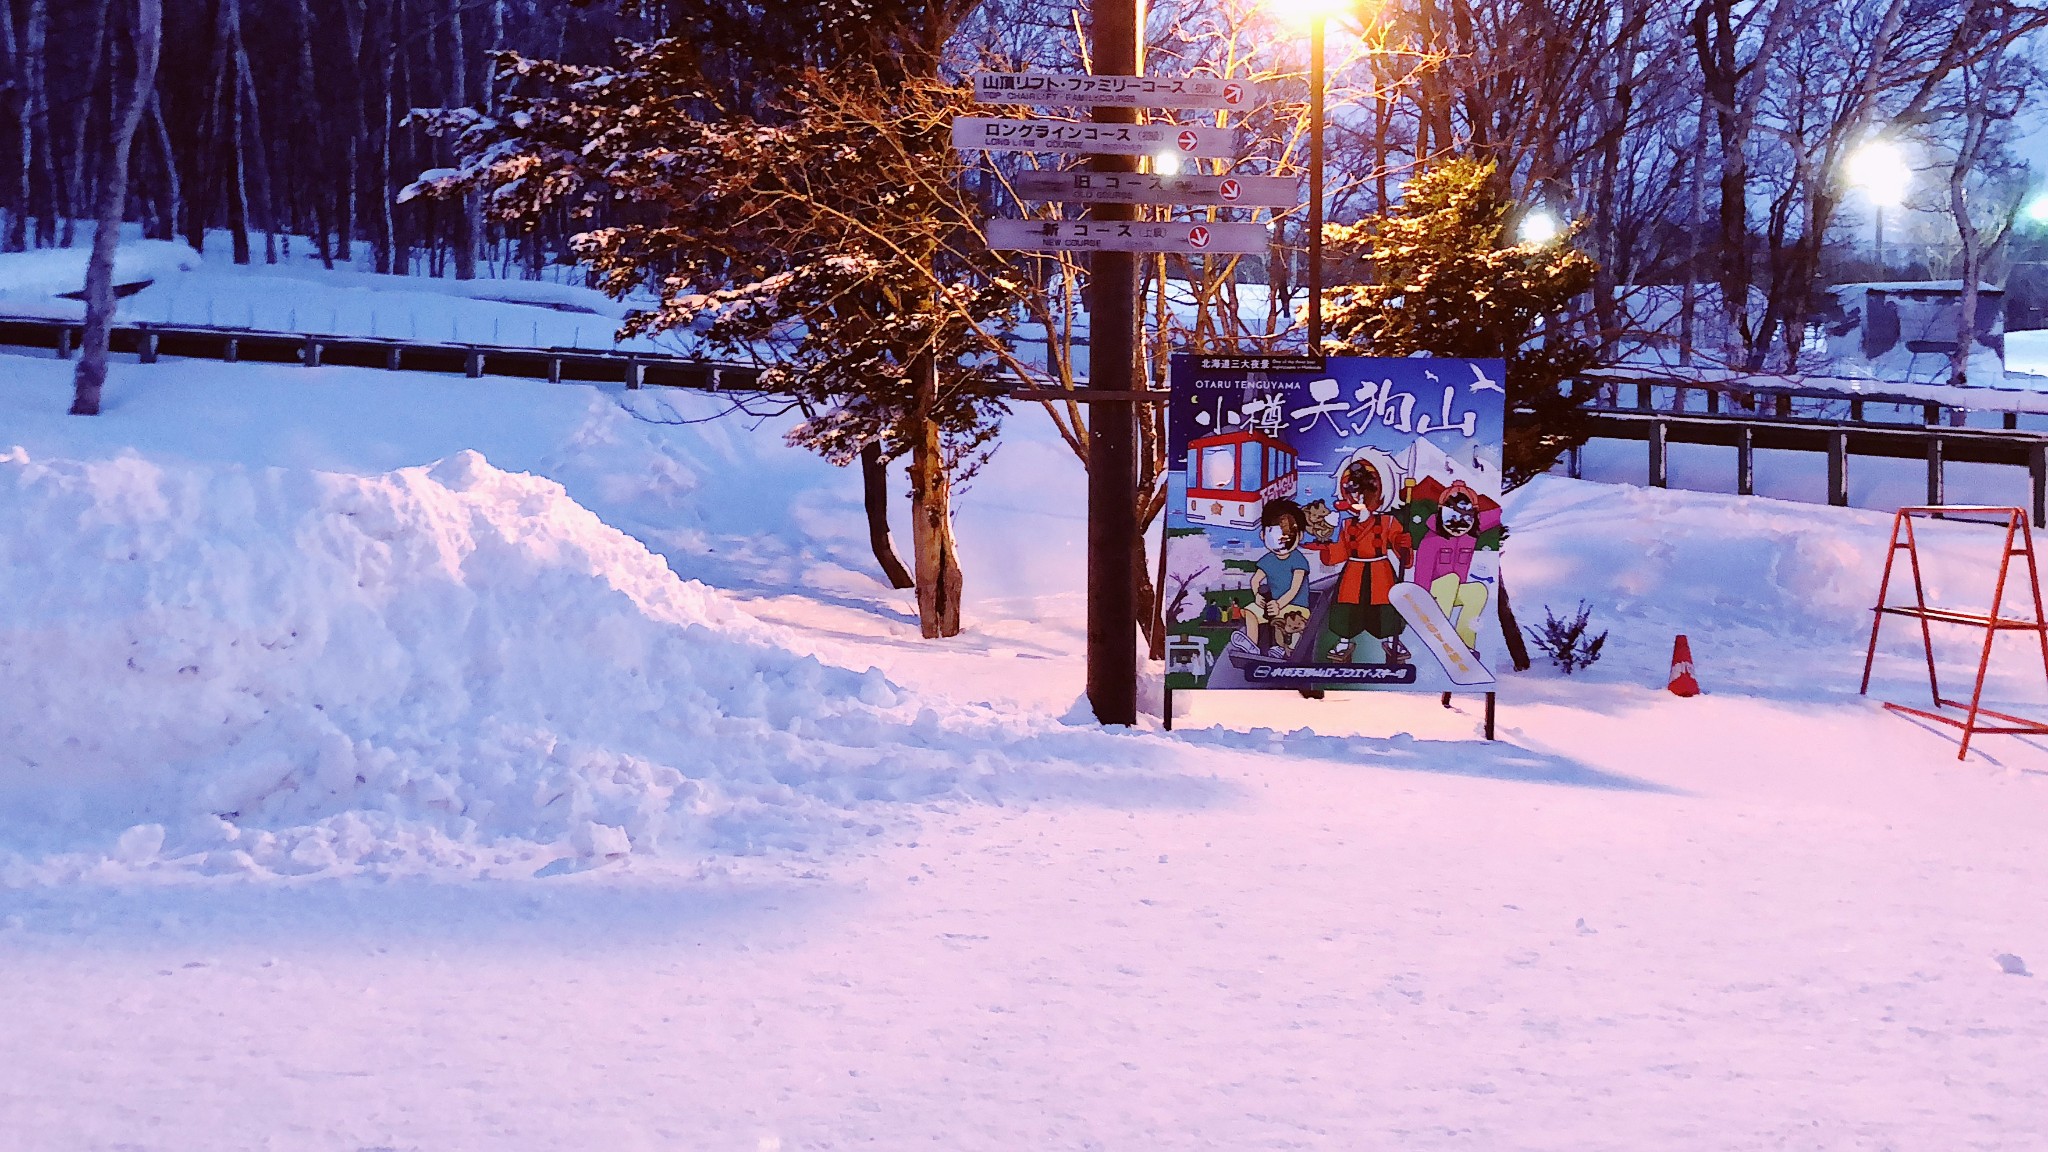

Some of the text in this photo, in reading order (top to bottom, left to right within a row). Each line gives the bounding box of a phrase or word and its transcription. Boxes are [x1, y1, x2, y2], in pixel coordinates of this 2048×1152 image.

[983, 75, 1187, 93] 山頂リフト・ファミリーコース
[985, 123, 1131, 141] ロングラインコース
[1042, 239, 1101, 248] NEW COURSE
[1201, 358, 1270, 371] 北海道三大夜景
[1195, 380, 1301, 390] OTARU TENGUYAMA
